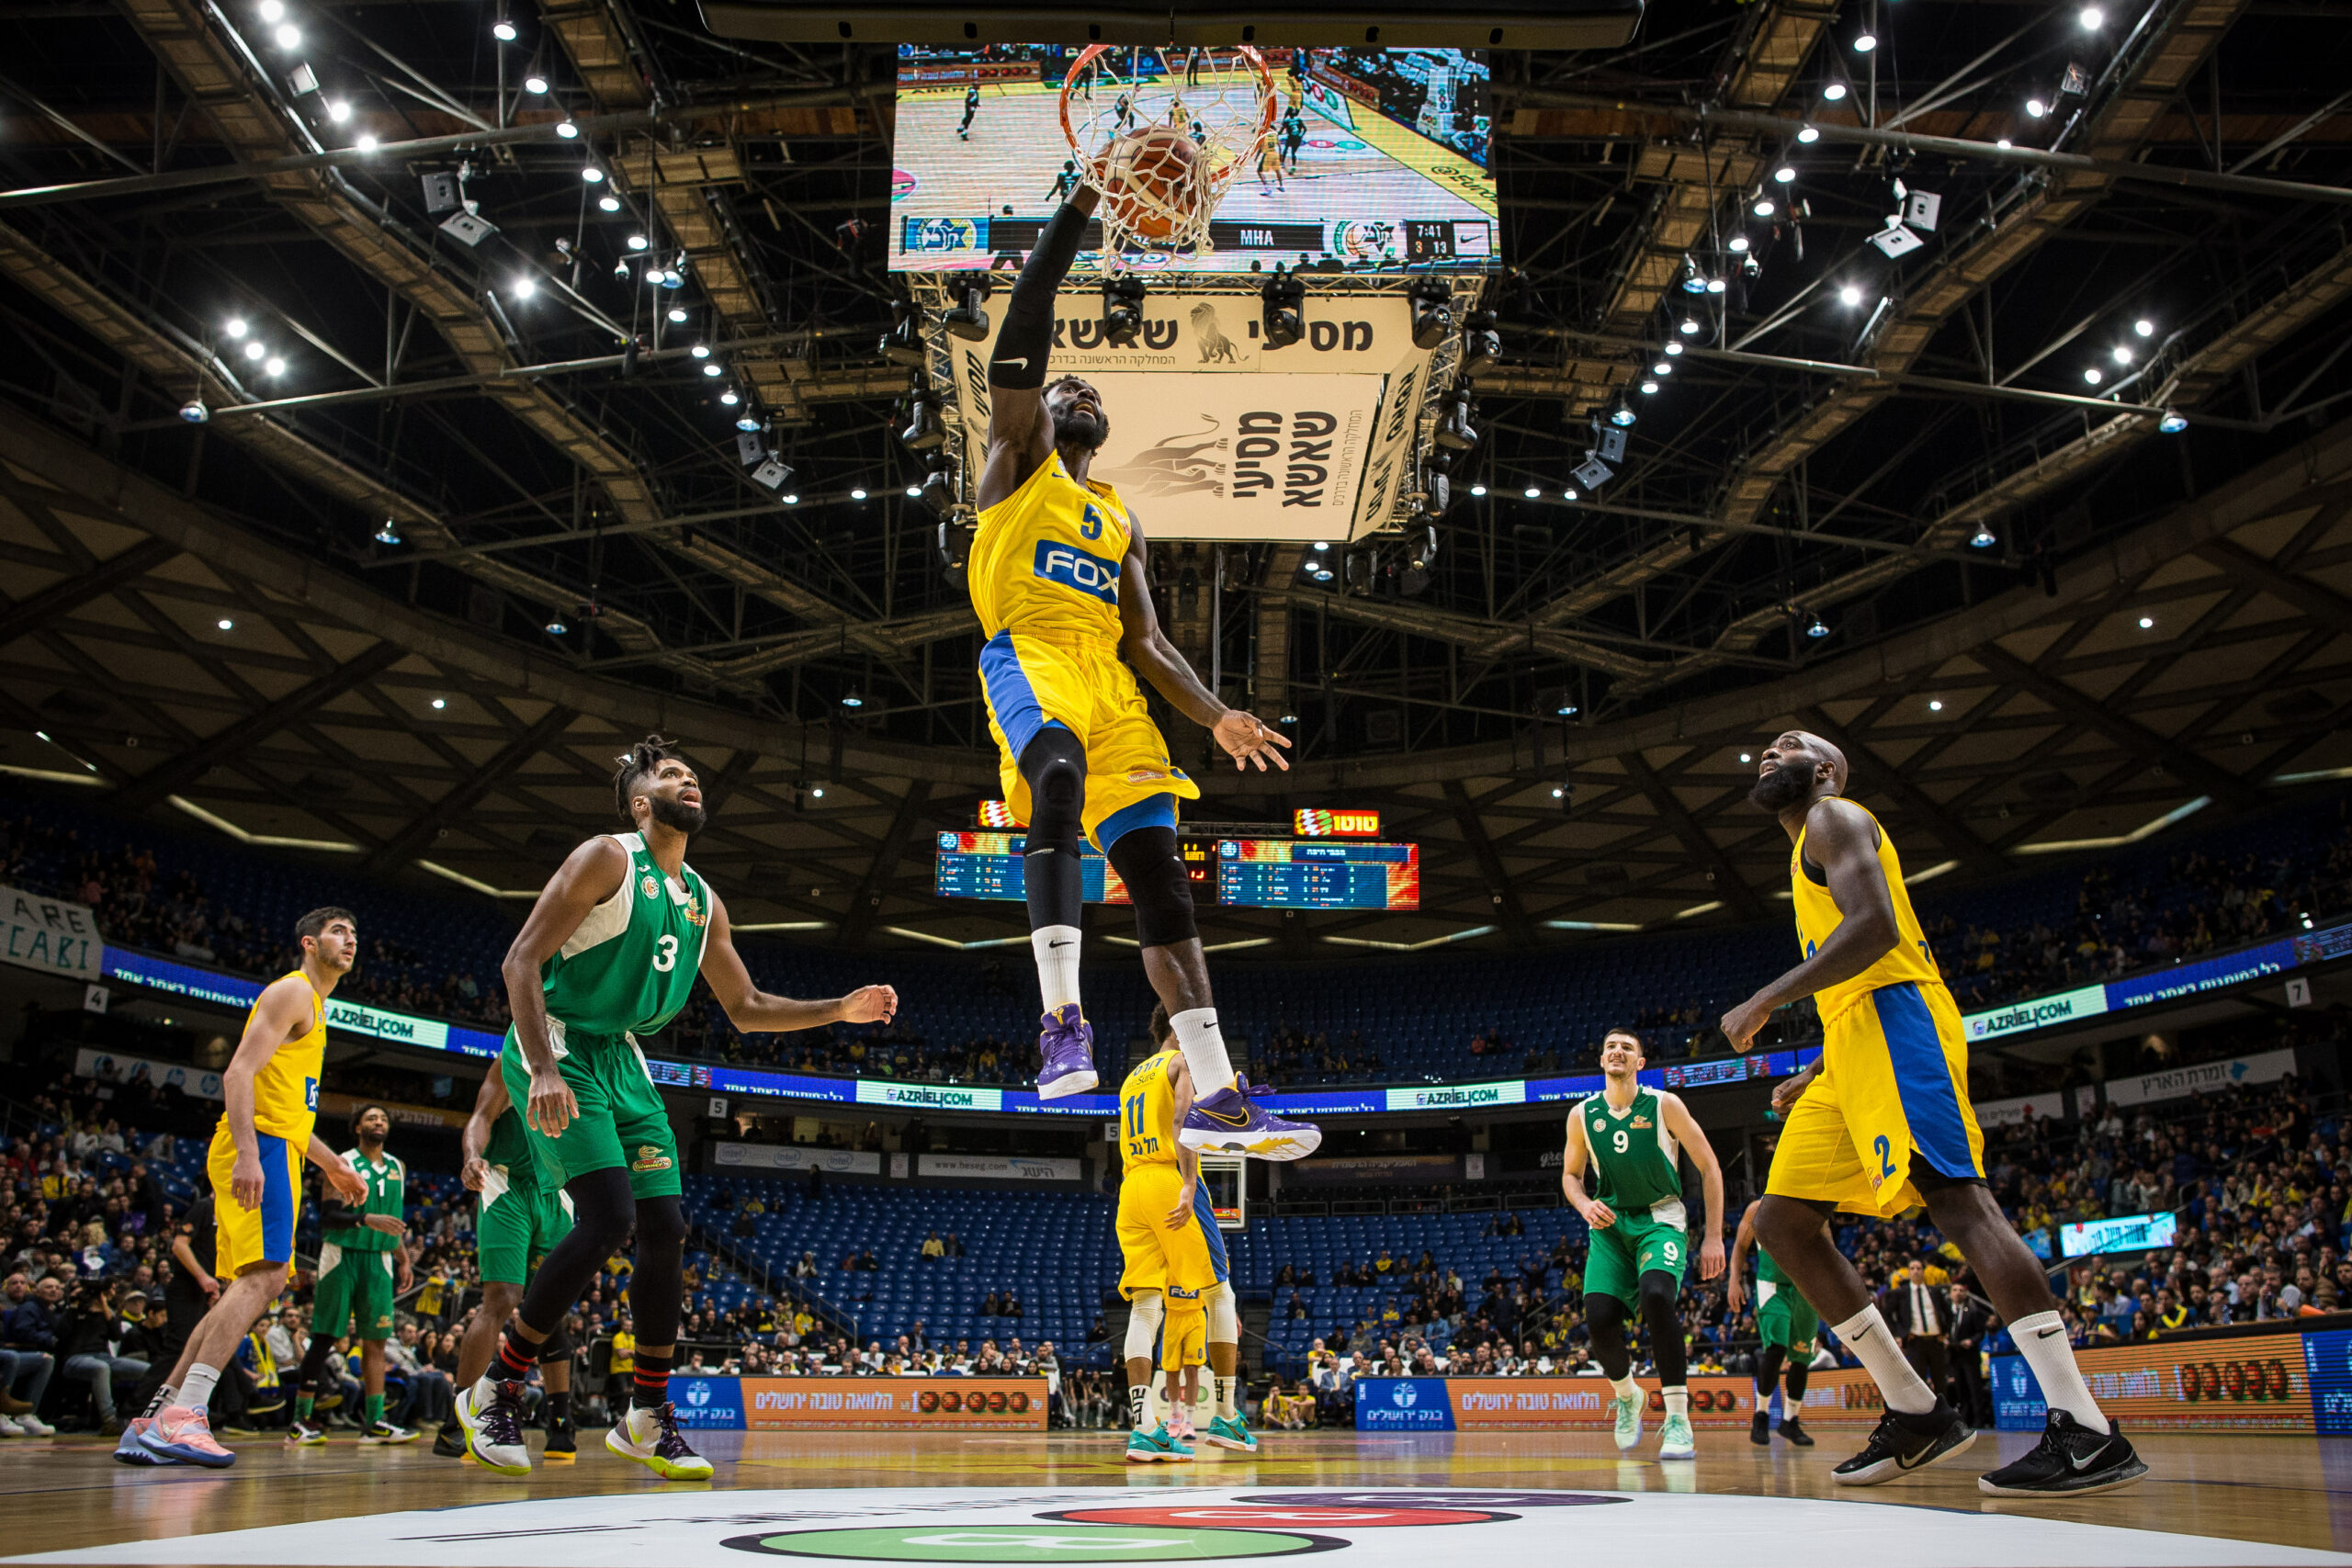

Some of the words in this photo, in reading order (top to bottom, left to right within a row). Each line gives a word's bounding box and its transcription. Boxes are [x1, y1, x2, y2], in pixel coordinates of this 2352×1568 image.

[1240, 230, 1274, 246] MHA
[1417, 224, 1442, 238] 7:41
[1433, 241, 1447, 254] 13
[1248, 319, 1374, 351] מסי
[1049, 355, 1076, 364] בדרכ
[1080, 355, 1126, 365] הראשונה
[1129, 354, 1176, 367] המחלקה
[1232, 412, 1283, 499] מסיעי
[1282, 412, 1337, 508] שאשא
[1080, 502, 1102, 540] 5
[1046, 550, 1118, 595] FOX
[1333, 815, 1378, 832] טוטו
[15, 897, 85, 934] ARE
[652, 934, 678, 972] 3
[91, 991, 101, 1007] 4
[2292, 985, 2301, 1001] 7
[2142, 1071, 2184, 1095] הארץ
[2187, 1064, 2226, 1085] זמרת
[714, 1100, 723, 1114] 5
[1125, 1092, 1145, 1138] 11
[1110, 1126, 1118, 1138] 5
[1613, 1130, 1629, 1154] 9
[1873, 1134, 1896, 1180] 2
[1023, 1166, 1055, 1178] הישג
[377, 1179, 386, 1197] 1
[1664, 1241, 1679, 1261] 9
[755, 1390, 807, 1410] ירושלים
[809, 1393, 842, 1410] טובה
[845, 1390, 893, 1410] הלוואה
[1462, 1391, 1513, 1410] ירושלים
[1516, 1393, 1549, 1410] טובה
[1553, 1391, 1600, 1410] הלוואה
[673, 1406, 708, 1420] ירושל
[1367, 1407, 1416, 1420] ירושלים
[1419, 1411, 1443, 1420] בנק
